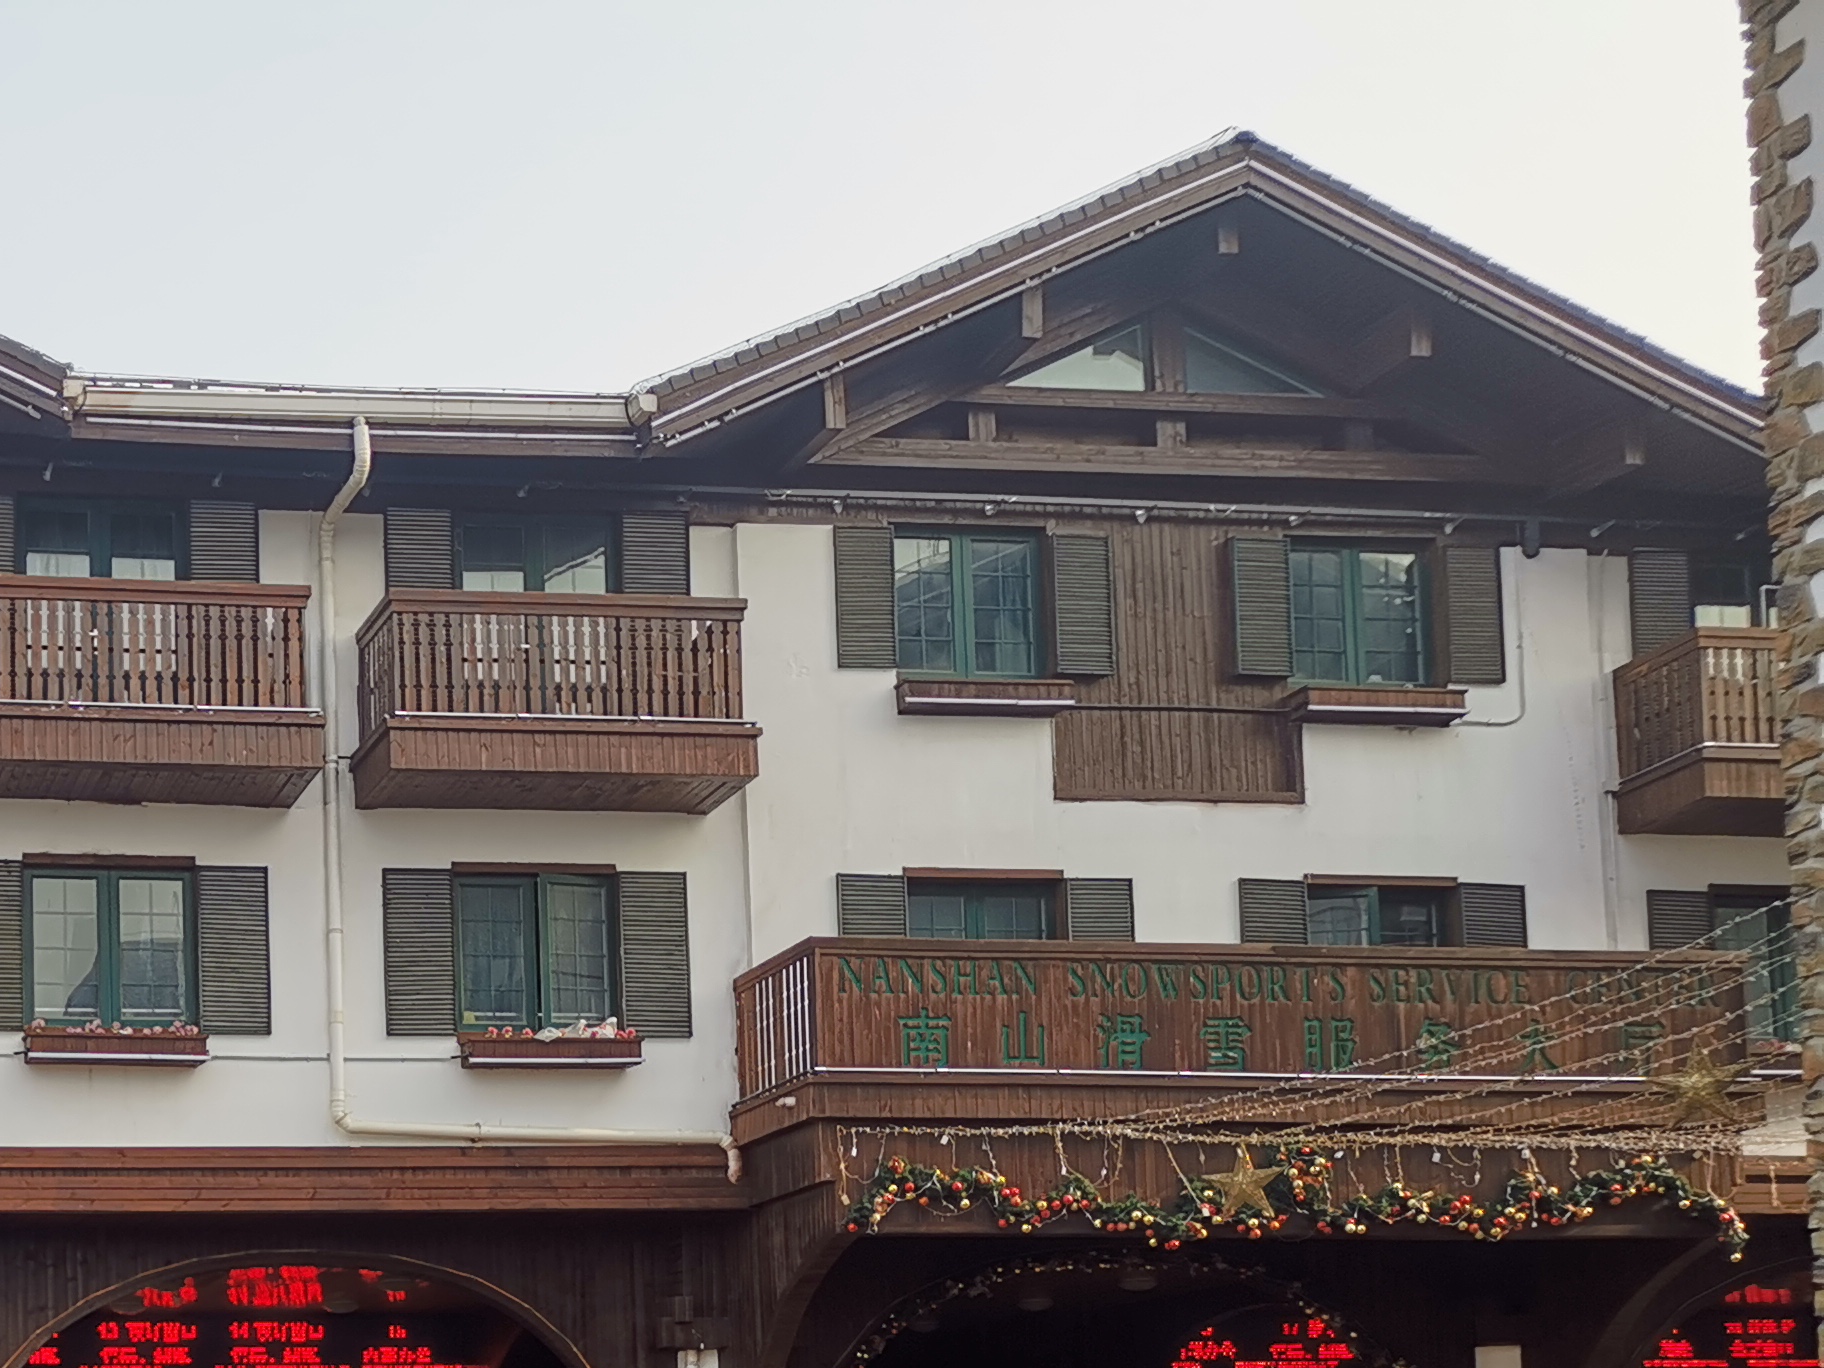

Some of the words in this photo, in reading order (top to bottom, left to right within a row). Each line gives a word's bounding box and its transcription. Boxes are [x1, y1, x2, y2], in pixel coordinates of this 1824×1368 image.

[837, 956, 1038, 997] NANSHAN
[1066, 960, 1347, 1003] SNOWSPORTS
[1369, 965, 1530, 1006] SERVICE
[897, 1007, 1666, 1077] 南山滑雪服务大厅
